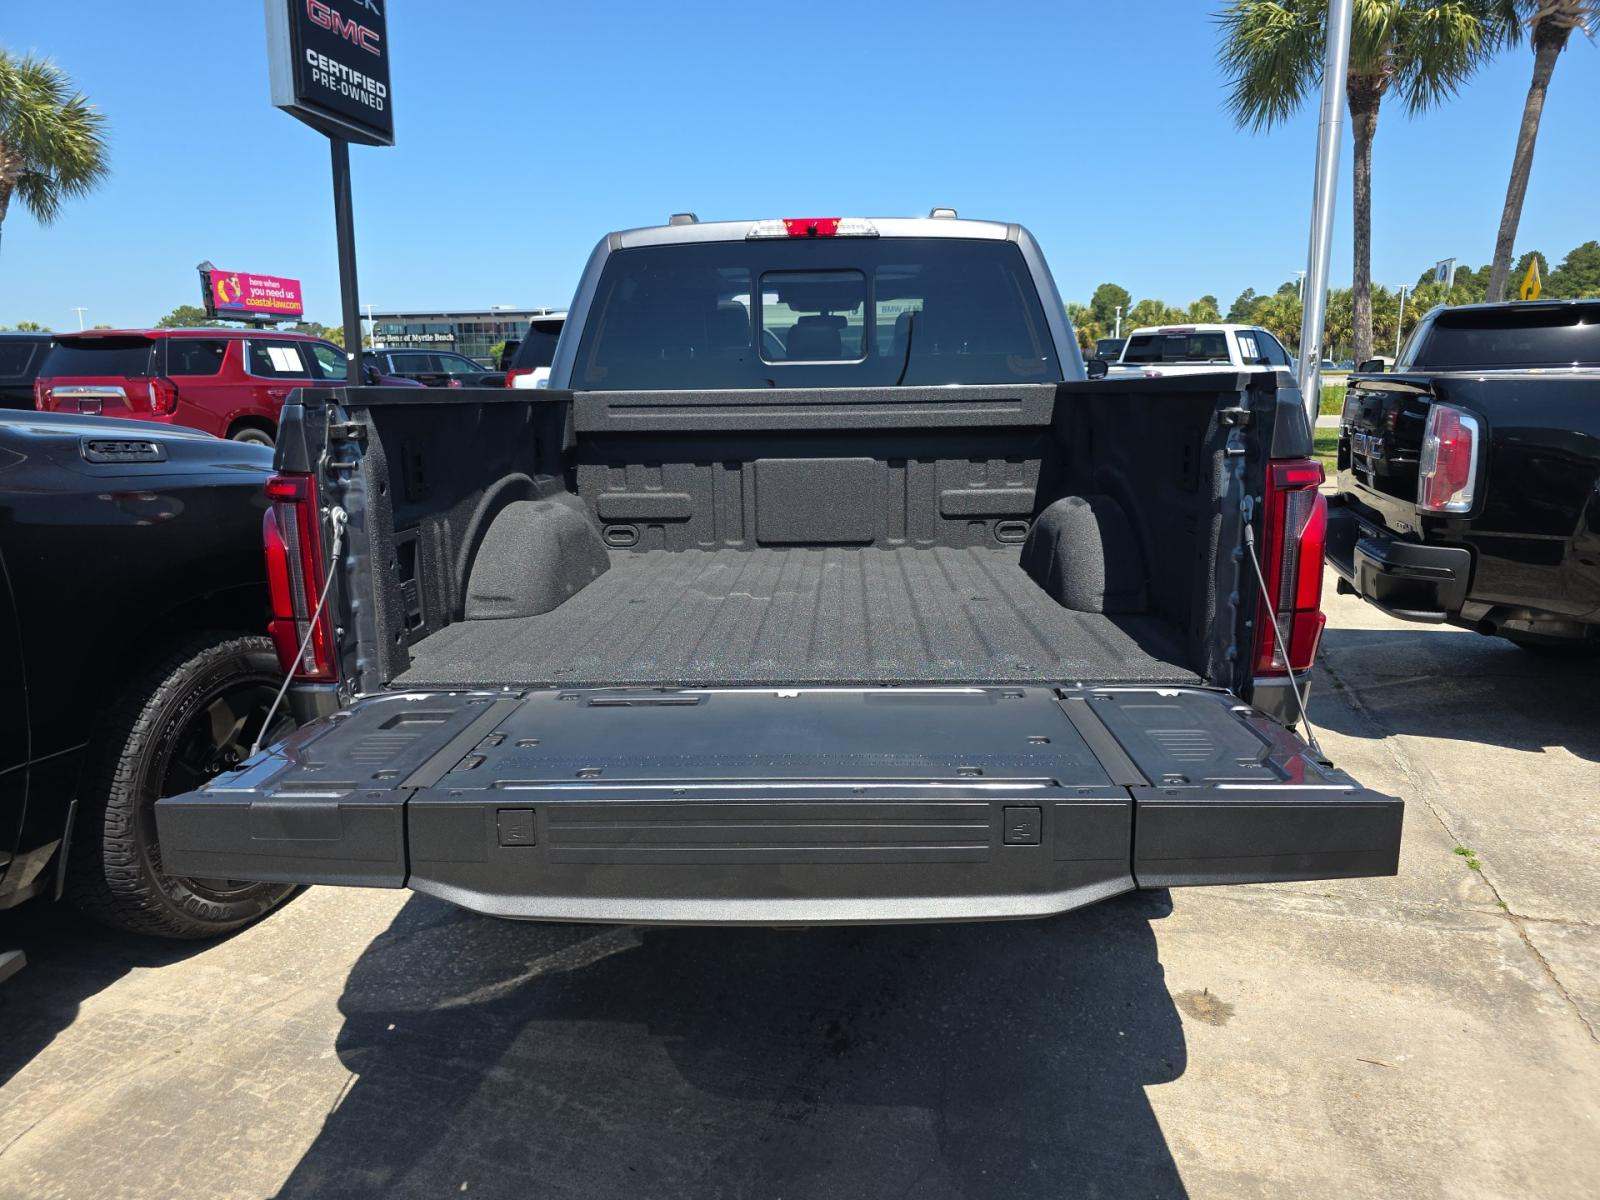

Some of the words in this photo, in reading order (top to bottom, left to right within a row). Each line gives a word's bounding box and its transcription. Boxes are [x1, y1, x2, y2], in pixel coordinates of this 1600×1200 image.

[307, 0, 380, 56] GMC
[306, 48, 387, 98] CERTIFIED
[312, 68, 384, 111] PRE-OWNED
[249, 278, 262, 287] here
[264, 280, 280, 288] when
[250, 287, 264, 297] you
[266, 289, 284, 298] need
[246, 298, 301, 309] coastal-law.com
[404, 333, 411, 341] of
[412, 334, 434, 343] Myrtle
[435, 333, 454, 341] Beach
